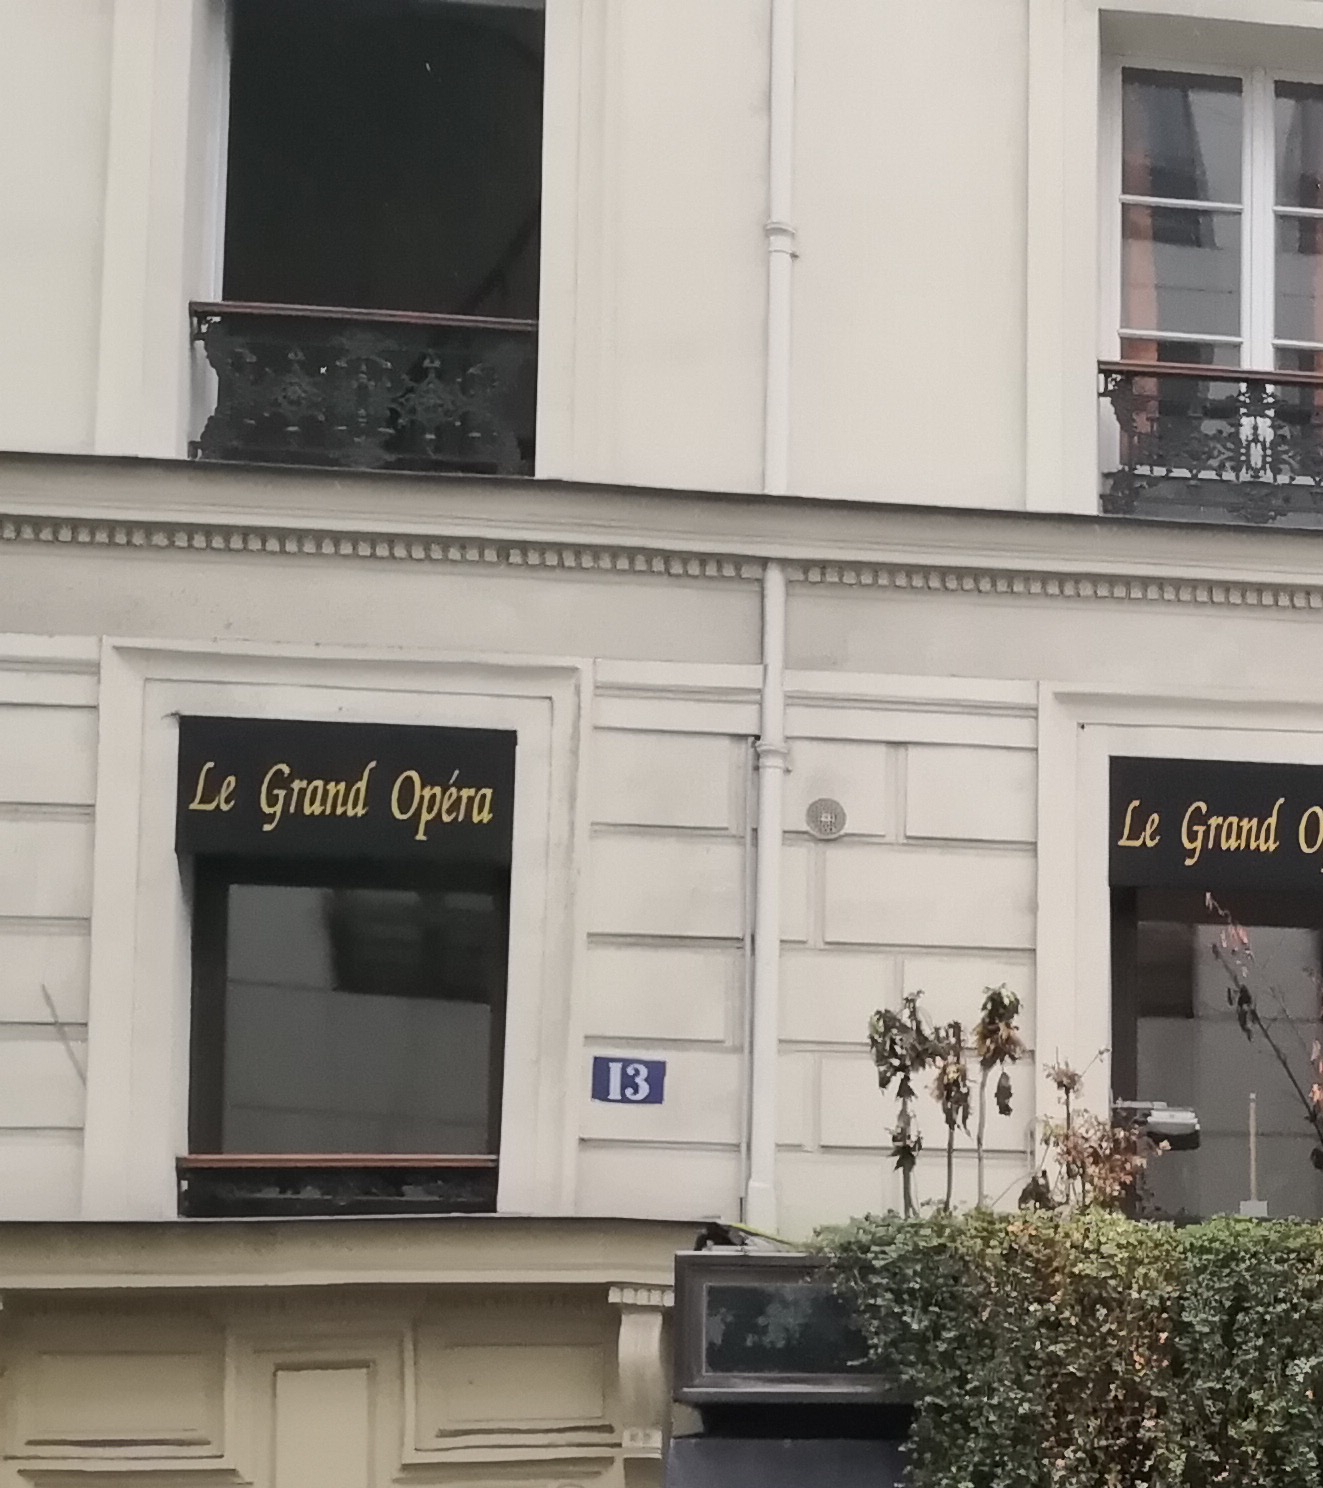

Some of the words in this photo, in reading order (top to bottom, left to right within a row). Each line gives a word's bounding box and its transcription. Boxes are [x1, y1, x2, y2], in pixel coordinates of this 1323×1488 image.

[188, 761, 236, 811] Le
[260, 760, 377, 832] Grand
[391, 769, 494, 840] Opéra
[1118, 800, 1160, 847] Le
[1181, 797, 1285, 866] Grand
[607, 1062, 650, 1101] 13
